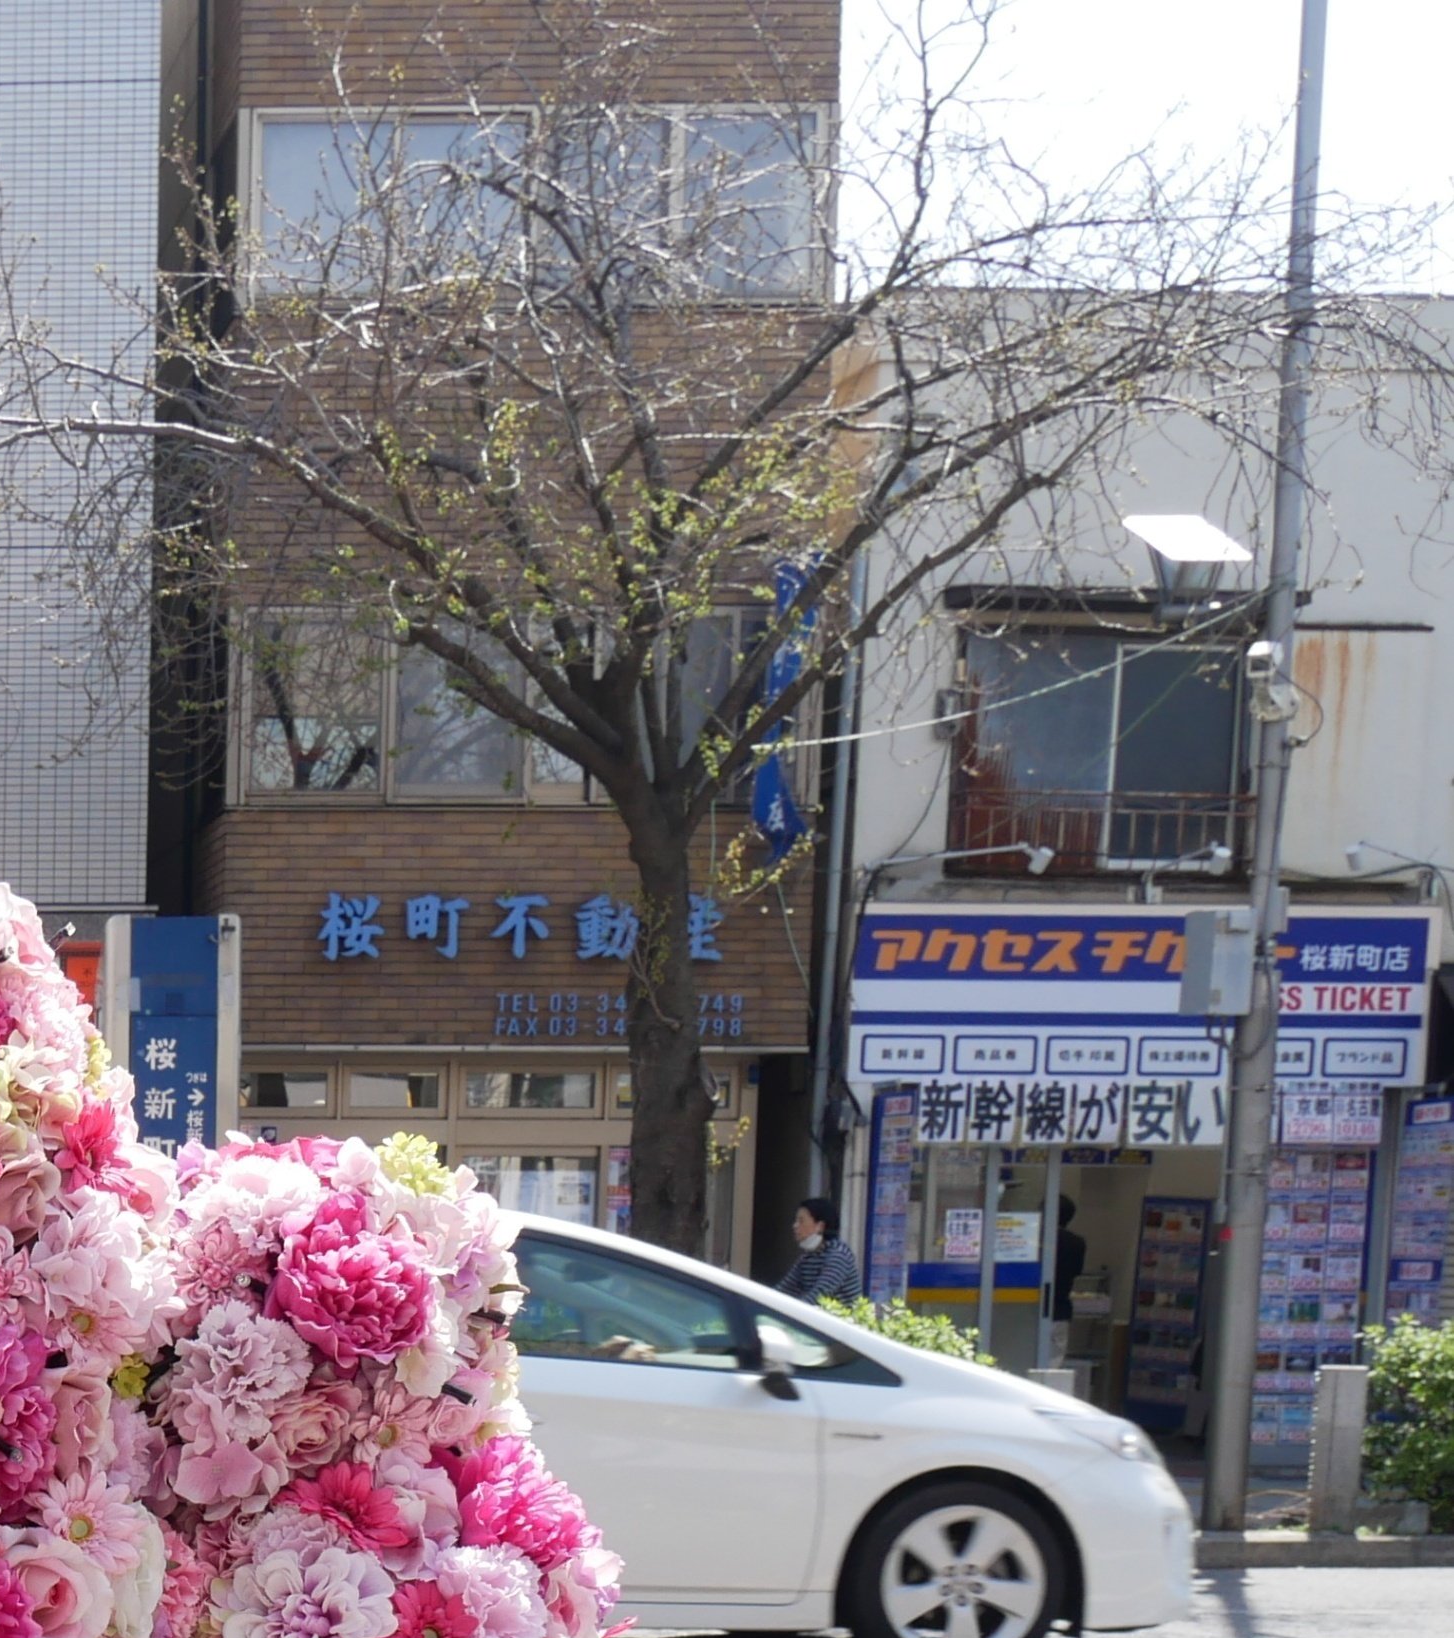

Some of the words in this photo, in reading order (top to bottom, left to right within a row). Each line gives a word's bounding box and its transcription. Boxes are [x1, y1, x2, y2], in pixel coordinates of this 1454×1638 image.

[1300, 944, 1411, 972] 桜新町店
[496, 993, 539, 1013] TEL
[1314, 986, 1413, 1012] TICKET
[495, 1018, 538, 1036] FAX
[185, 1072, 207, 1084] つぎは
[920, 1079, 1225, 1143] 新幹線が安い
